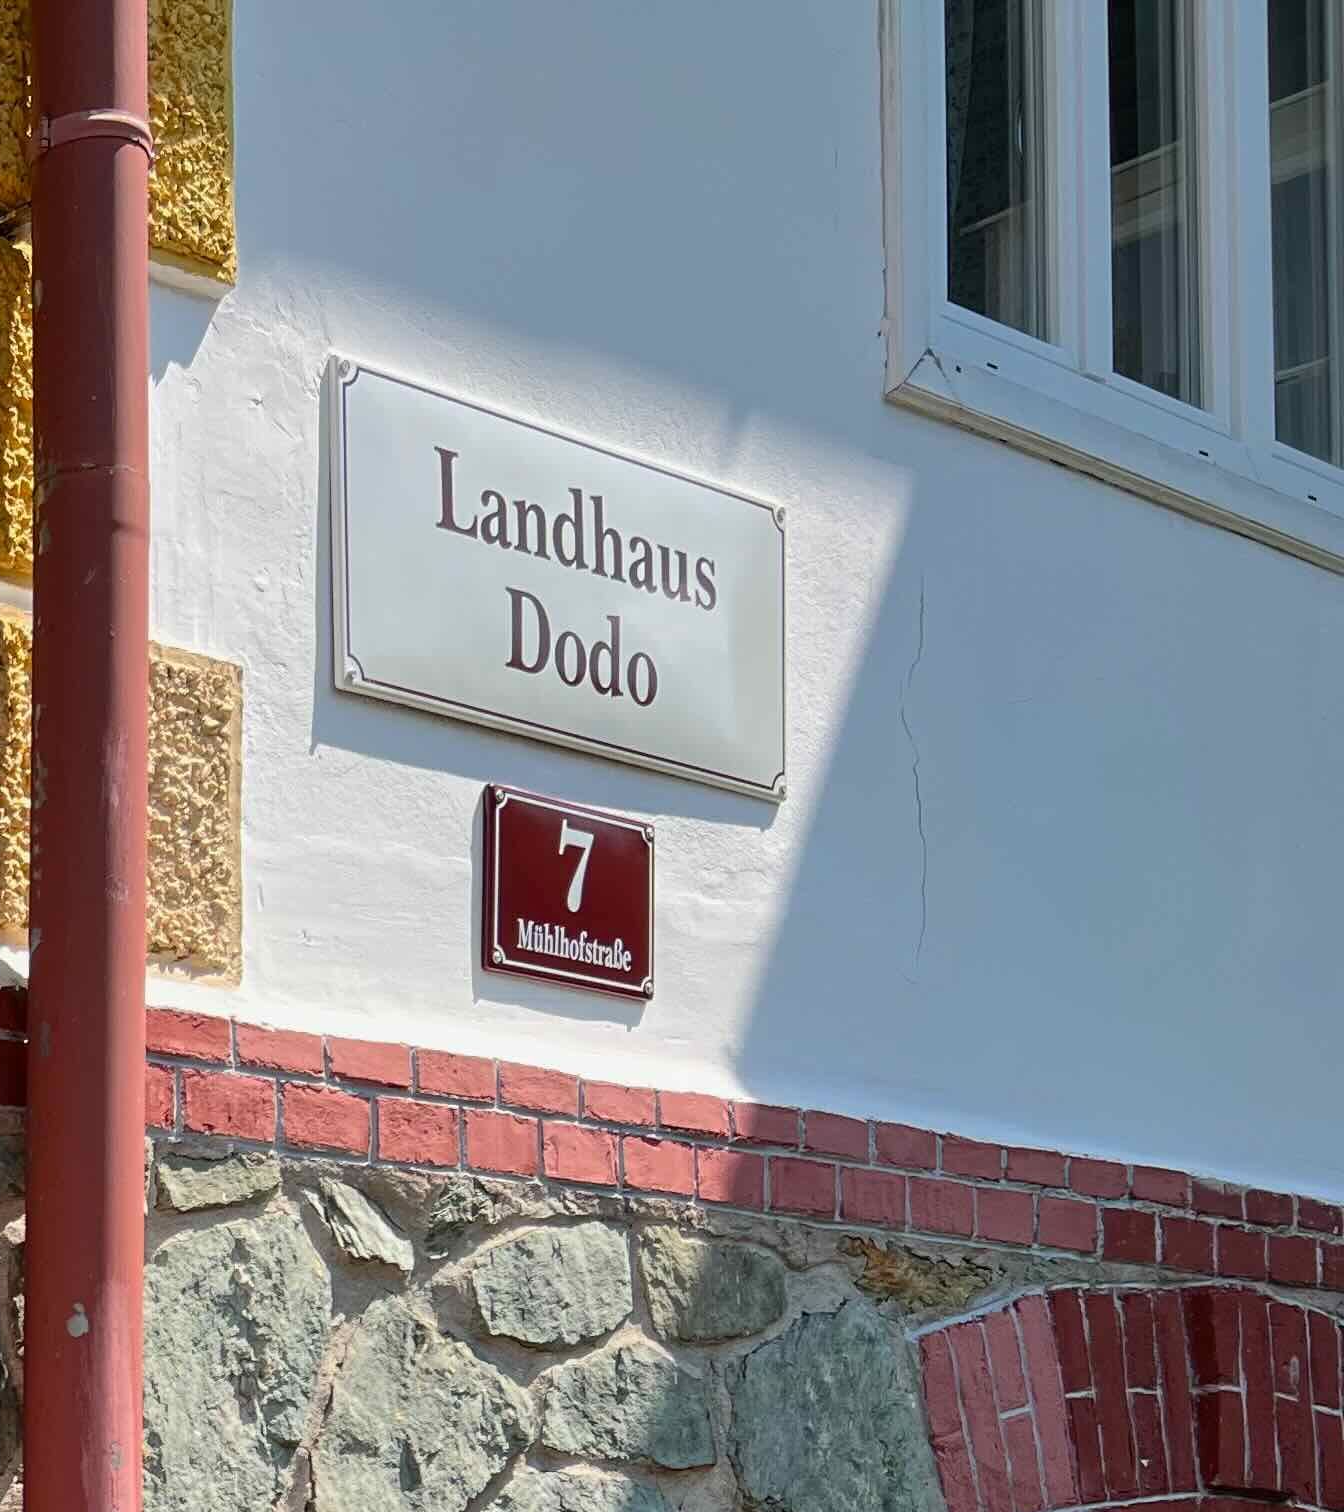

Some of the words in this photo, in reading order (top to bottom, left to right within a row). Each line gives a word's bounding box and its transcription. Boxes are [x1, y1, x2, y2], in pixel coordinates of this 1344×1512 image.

[434, 447, 717, 609] Landhaus
[505, 587, 658, 707] Dodo
[559, 819, 594, 913] 7
[517, 918, 632, 972] Mühlhofstraße
